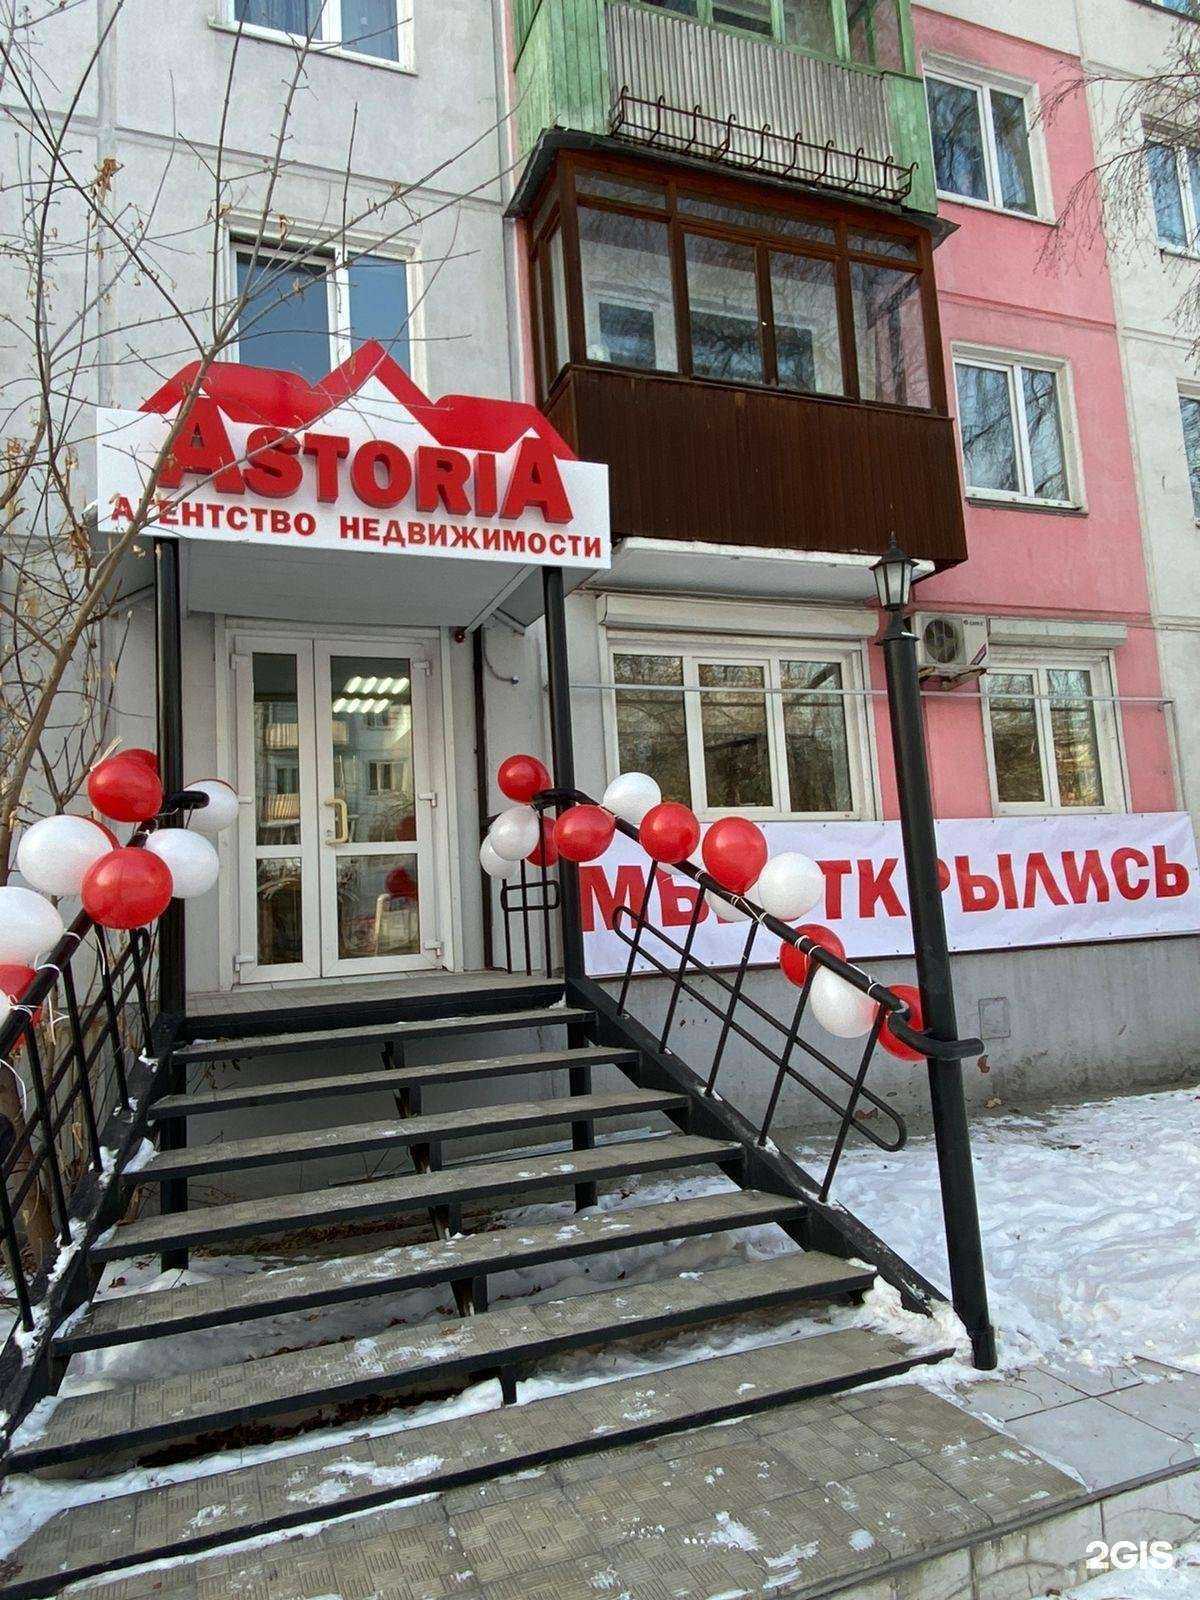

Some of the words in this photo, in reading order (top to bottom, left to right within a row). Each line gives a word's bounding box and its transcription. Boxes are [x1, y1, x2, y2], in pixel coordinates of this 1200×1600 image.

[156, 398, 574, 525] ASTORIA
[339, 516, 602, 559] НЕДВИЖИМОСТИ
[752, 844, 1190, 923] ТКЫЛИСЬ
